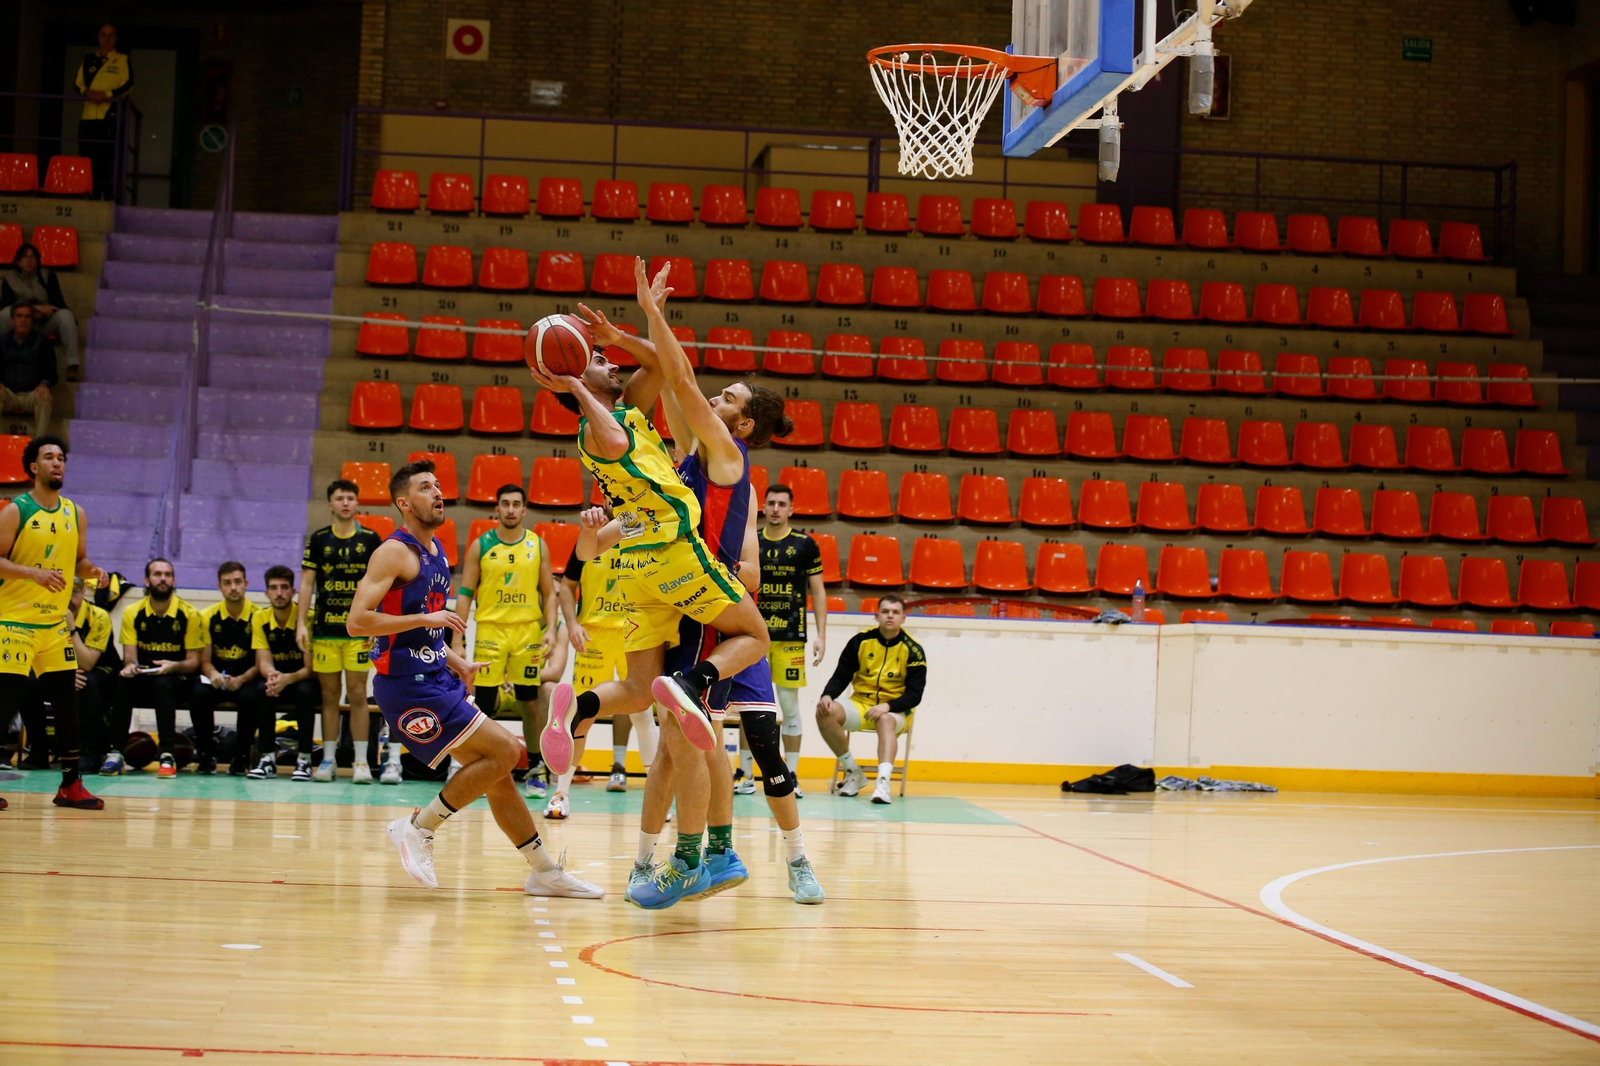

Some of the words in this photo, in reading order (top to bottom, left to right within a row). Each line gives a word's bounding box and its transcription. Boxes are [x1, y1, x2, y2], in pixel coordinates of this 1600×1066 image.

[1404, 38, 1431, 48] SALIDA
[55, 205, 73, 218] 22
[387, 220, 403, 232] 21
[442, 223, 460, 234] 20
[499, 225, 514, 236] 19
[556, 226, 570, 238] 18
[610, 229, 624, 241] 17
[665, 233, 679, 244] 16
[775, 238, 790, 249] 14
[884, 242, 898, 254] 12
[938, 245, 951, 257] 11
[993, 248, 1007, 259] 10
[1046, 251, 1056, 261] 9
[1099, 253, 1109, 264] 8
[1155, 255, 1163, 267] 7
[1206, 259, 1216, 270] 6
[1311, 264, 1320, 275] 4
[1416, 269, 1424, 280] 2
[382, 296, 398, 308] 21
[438, 299, 456, 310] 20
[498, 301, 513, 313] 19
[611, 306, 626, 318] 17
[669, 309, 684, 320] 16
[781, 314, 796, 326] 14
[894, 319, 909, 332] 12
[950, 322, 963, 334] 11
[1005, 325, 1020, 336] 10
[1061, 327, 1071, 338] 9
[1115, 330, 1125, 341] 8
[1172, 330, 1181, 343] 7
[1224, 334, 1234, 345] 6
[1332, 339, 1341, 350] 4
[1439, 343, 1448, 355] 2
[372, 368, 390, 381] 21
[431, 371, 450, 383] 20
[493, 374, 509, 386] 19
[785, 386, 800, 399] 14
[902, 392, 918, 405] 12
[959, 394, 972, 406] 11
[1016, 397, 1033, 409] 10
[1074, 400, 1084, 411] 9
[1130, 401, 1140, 413] 8
[1188, 403, 1197, 416] 7
[1244, 406, 1254, 418] 6
[1353, 411, 1363, 423] 4
[1464, 416, 1474, 428] 2
[368, 441, 385, 452] 21
[50, 522, 57, 534] 4
[508, 554, 515, 564] 9
[762, 582, 793, 595] BULÉ
[495, 589, 527, 604] Jaén
[773, 774, 786, 785] NBA
